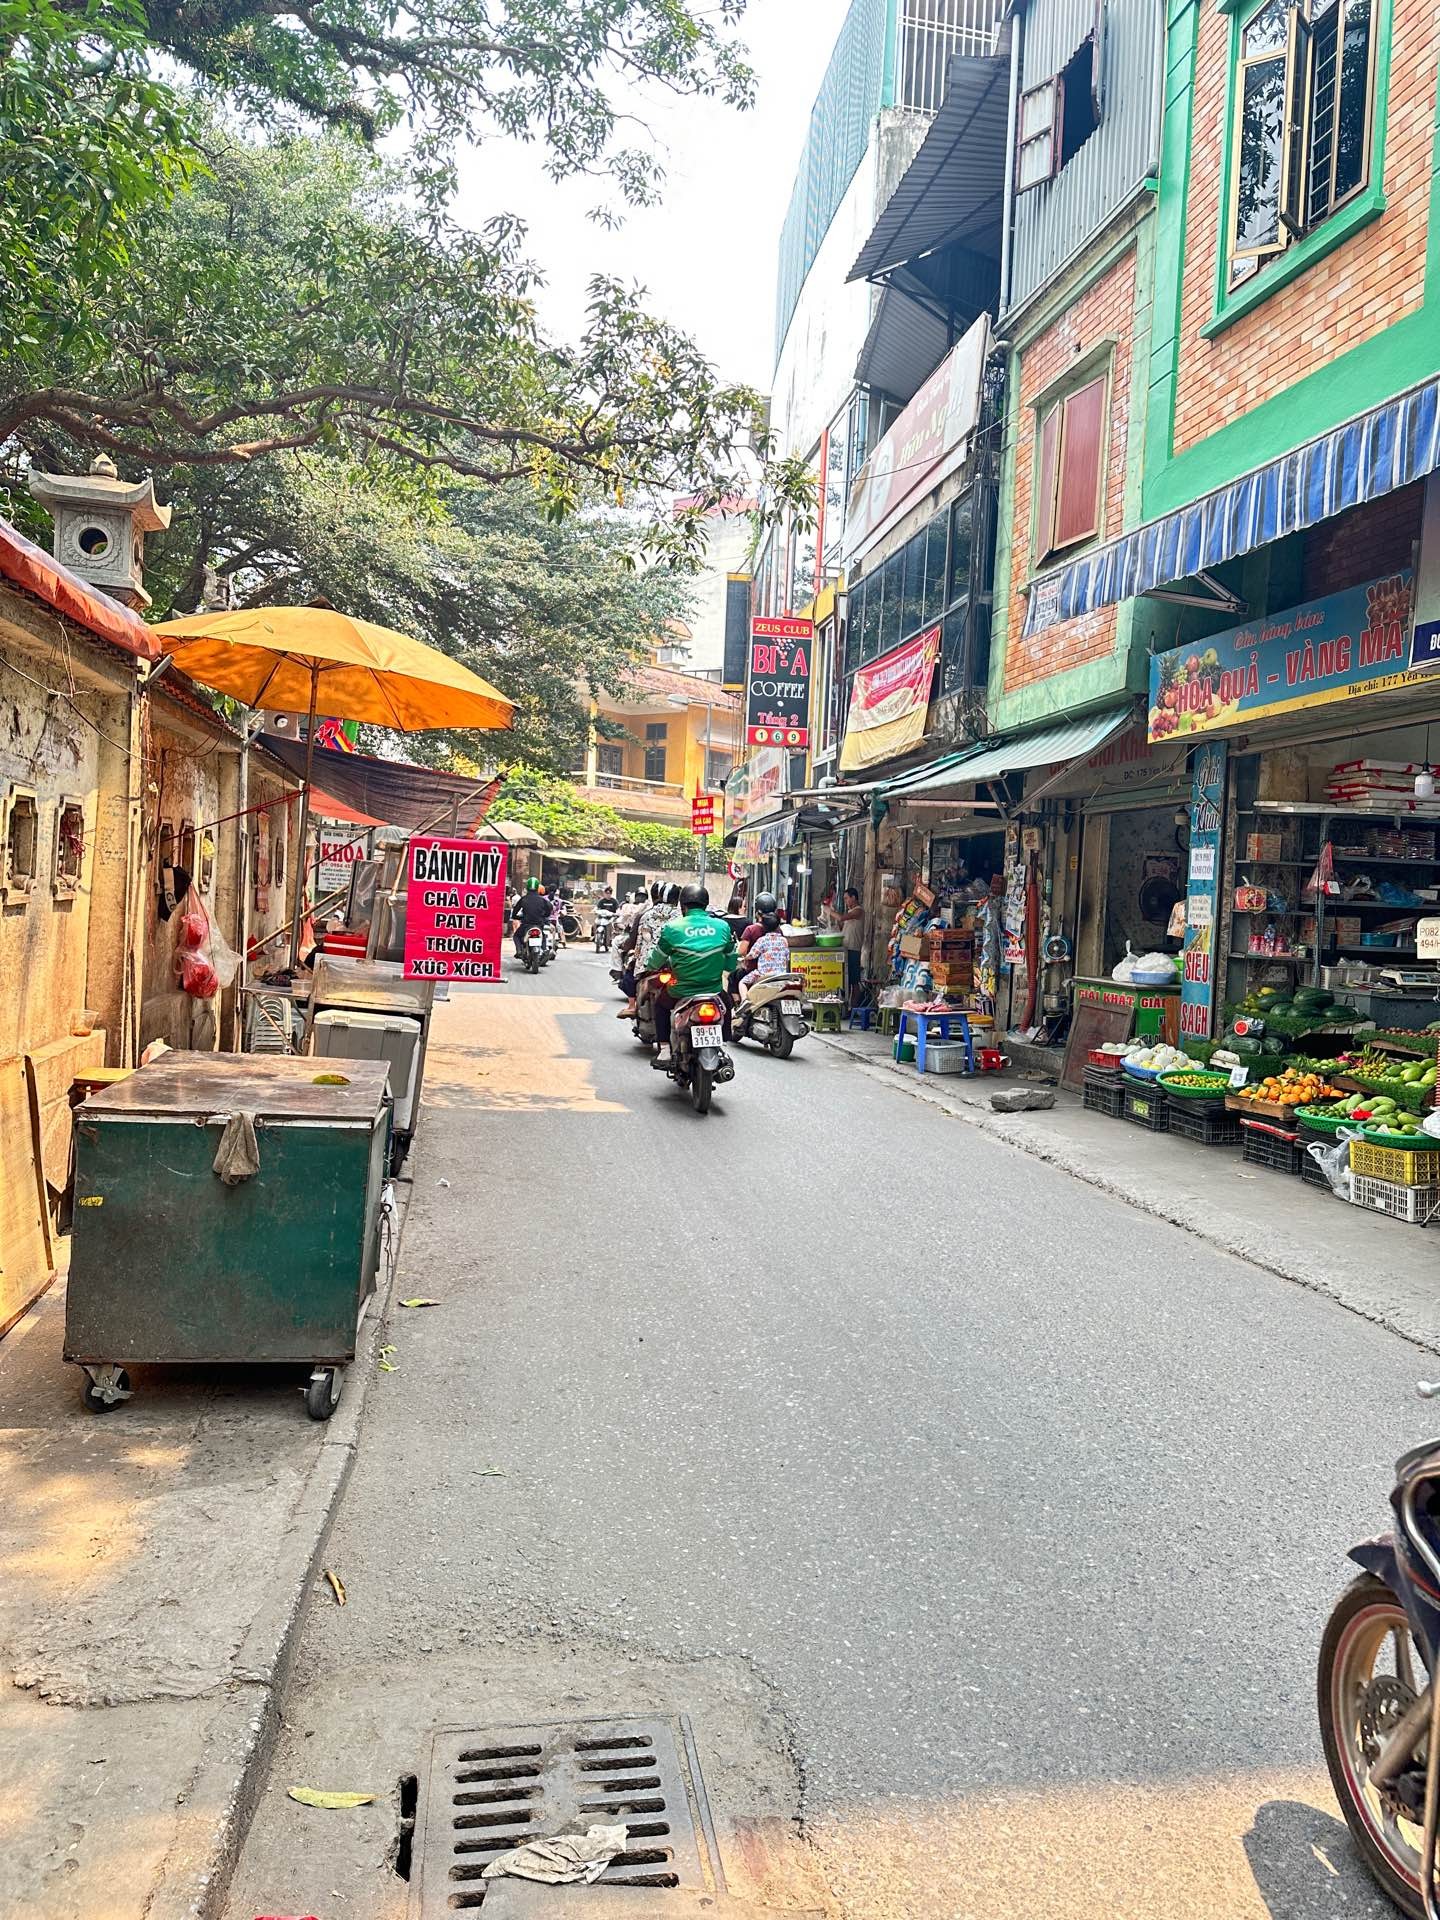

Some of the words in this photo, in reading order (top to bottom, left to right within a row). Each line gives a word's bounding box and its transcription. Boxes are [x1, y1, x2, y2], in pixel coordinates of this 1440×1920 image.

[755, 623, 781, 633] ZEUS
[783, 625, 810, 635] CLUB
[1177, 677, 1213, 714] HOA
[1219, 652, 1259, 705] QUẢ
[1286, 639, 1351, 686] VÀNG
[1382, 674, 1399, 688] 177
[751, 680, 805, 699] COFFEE
[790, 713, 799, 726] 2
[414, 843, 467, 883] BÁNH
[471, 848, 501, 885] MỲ
[424, 888, 459, 908] CHẢ
[465, 891, 488, 909] CÁ
[435, 913, 475, 929] PATE
[685, 923, 716, 937] Grab
[426, 934, 483, 954] TRỨNG
[412, 958, 447, 975] XÚC
[453, 959, 493, 977] XÍCH
